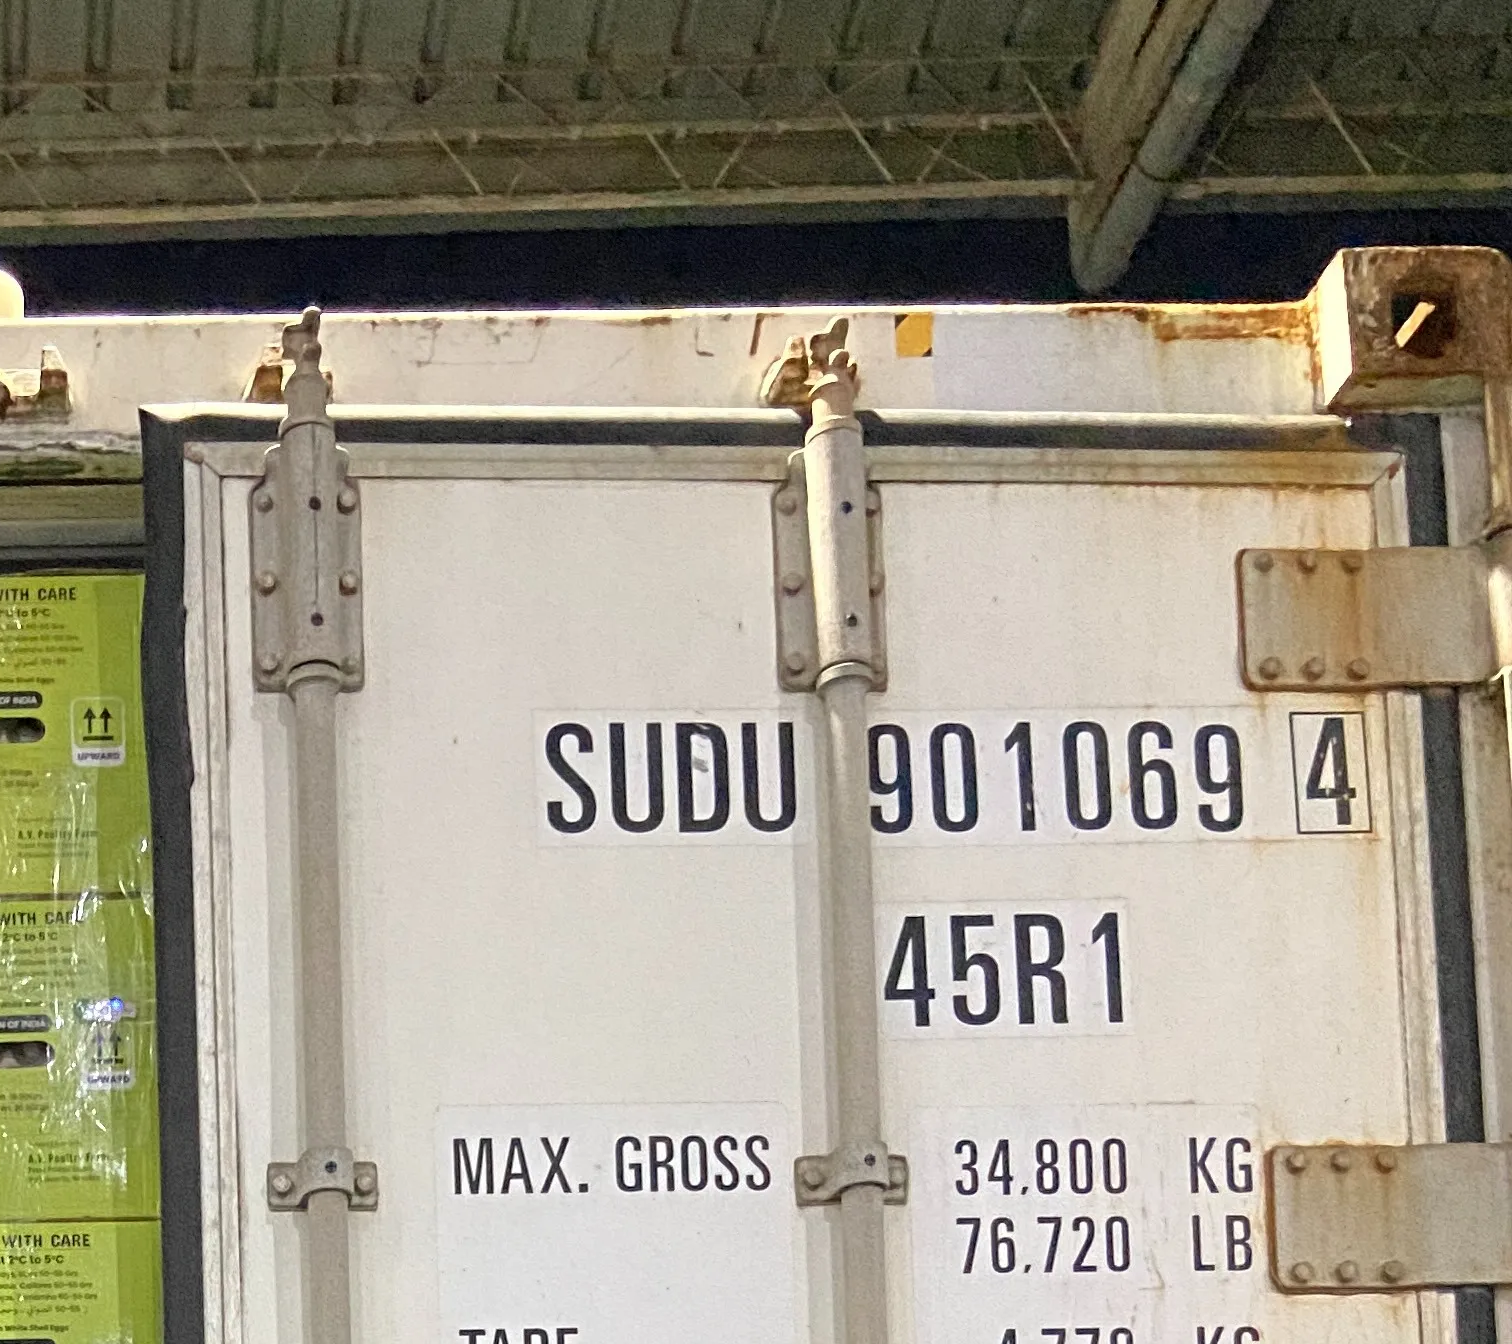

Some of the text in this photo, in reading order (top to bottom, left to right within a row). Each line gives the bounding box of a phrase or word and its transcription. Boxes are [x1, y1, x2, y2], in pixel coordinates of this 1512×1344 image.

[37, 587, 77, 602] CARE
[544, 716, 1357, 834] SUDU 901069 4
[884, 911, 1125, 1027] 45R1
[453, 1135, 772, 1196] MAX. GROSS
[1188, 1138, 1255, 1194] KG
[2, 1234, 43, 1249] WITH
[51, 1234, 91, 1248] CARE
[1193, 1216, 1254, 1272] LB
